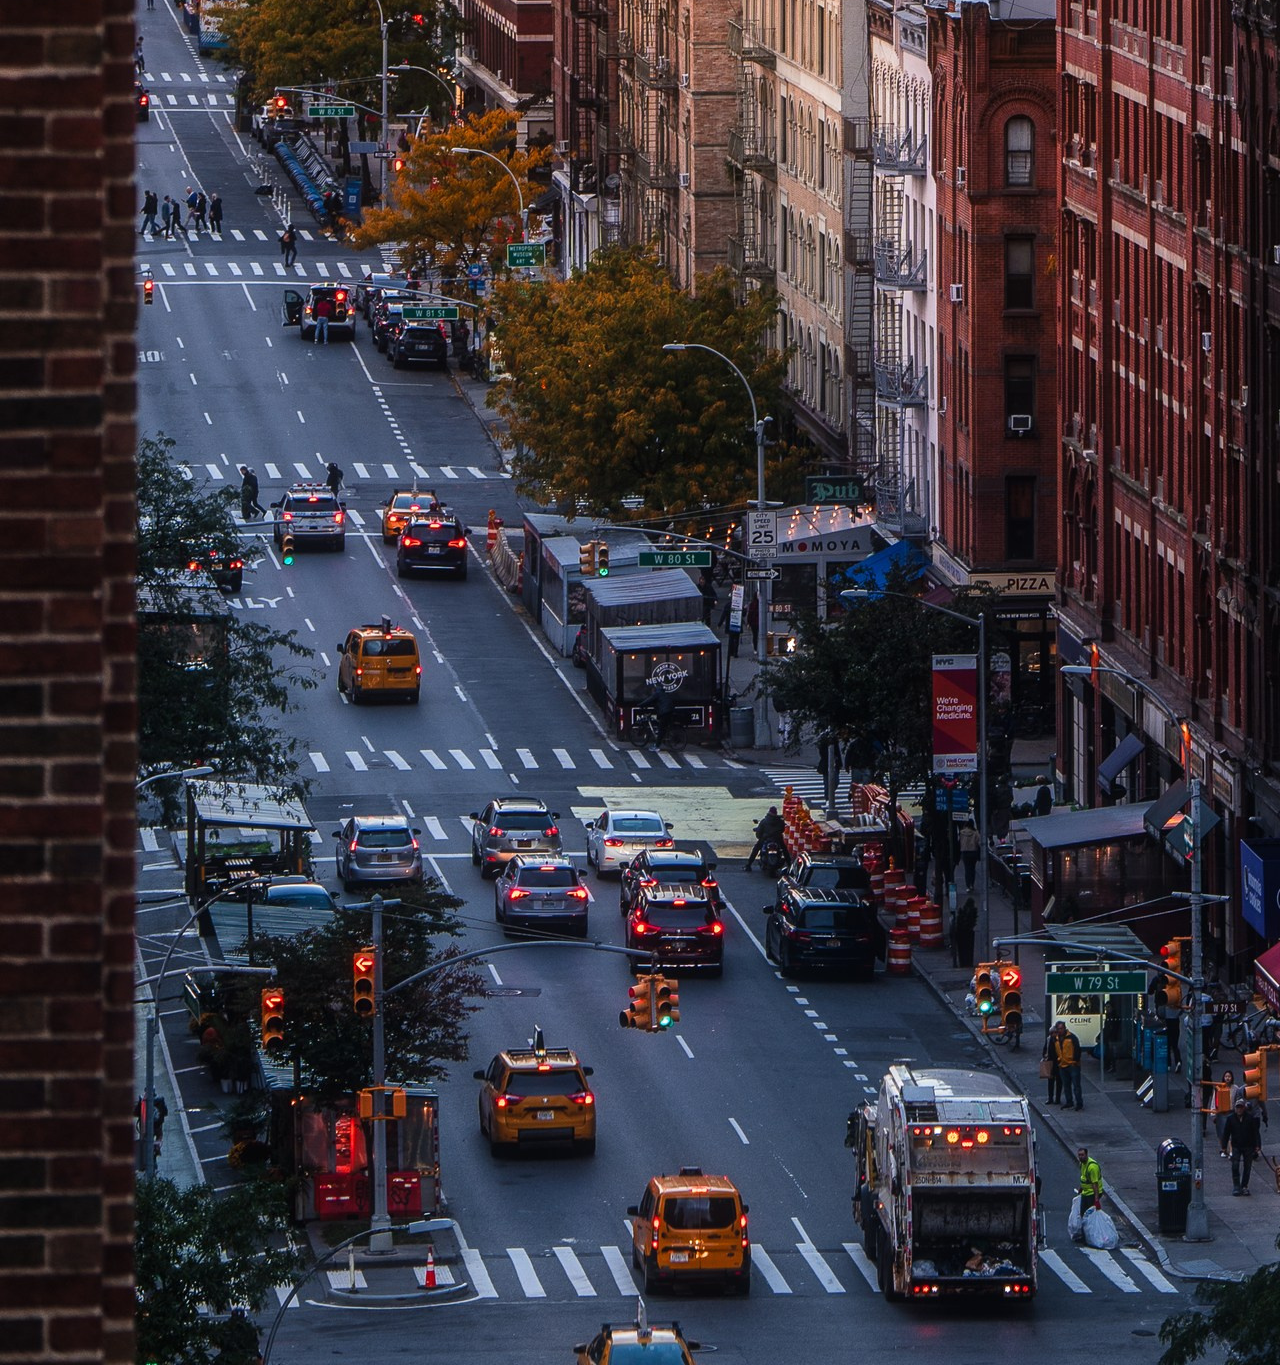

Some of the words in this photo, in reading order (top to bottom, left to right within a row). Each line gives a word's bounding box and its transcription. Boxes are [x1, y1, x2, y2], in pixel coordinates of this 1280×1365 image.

[438, 309, 445, 317] St
[811, 481, 859, 502] Pub
[752, 531, 774, 544] 25
[654, 555, 665, 564] W
[667, 555, 682, 564] 80
[685, 554, 696, 564] St
[1007, 578, 1050, 590] PIZZA
[225, 596, 284, 609] NLY
[935, 658, 954, 666] NYC
[645, 675, 665, 686] NEW
[666, 669, 689, 680] YORK
[936, 696, 959, 704] We're
[936, 703, 973, 712] Changing
[936, 712, 973, 720] Medicine.
[1074, 978, 1083, 990] W
[1088, 977, 1102, 990] 79
[1107, 977, 1119, 990] St
[1213, 1004, 1219, 1012] W
[1220, 1004, 1229, 1012] 79
[1231, 1004, 1237, 1012] St
